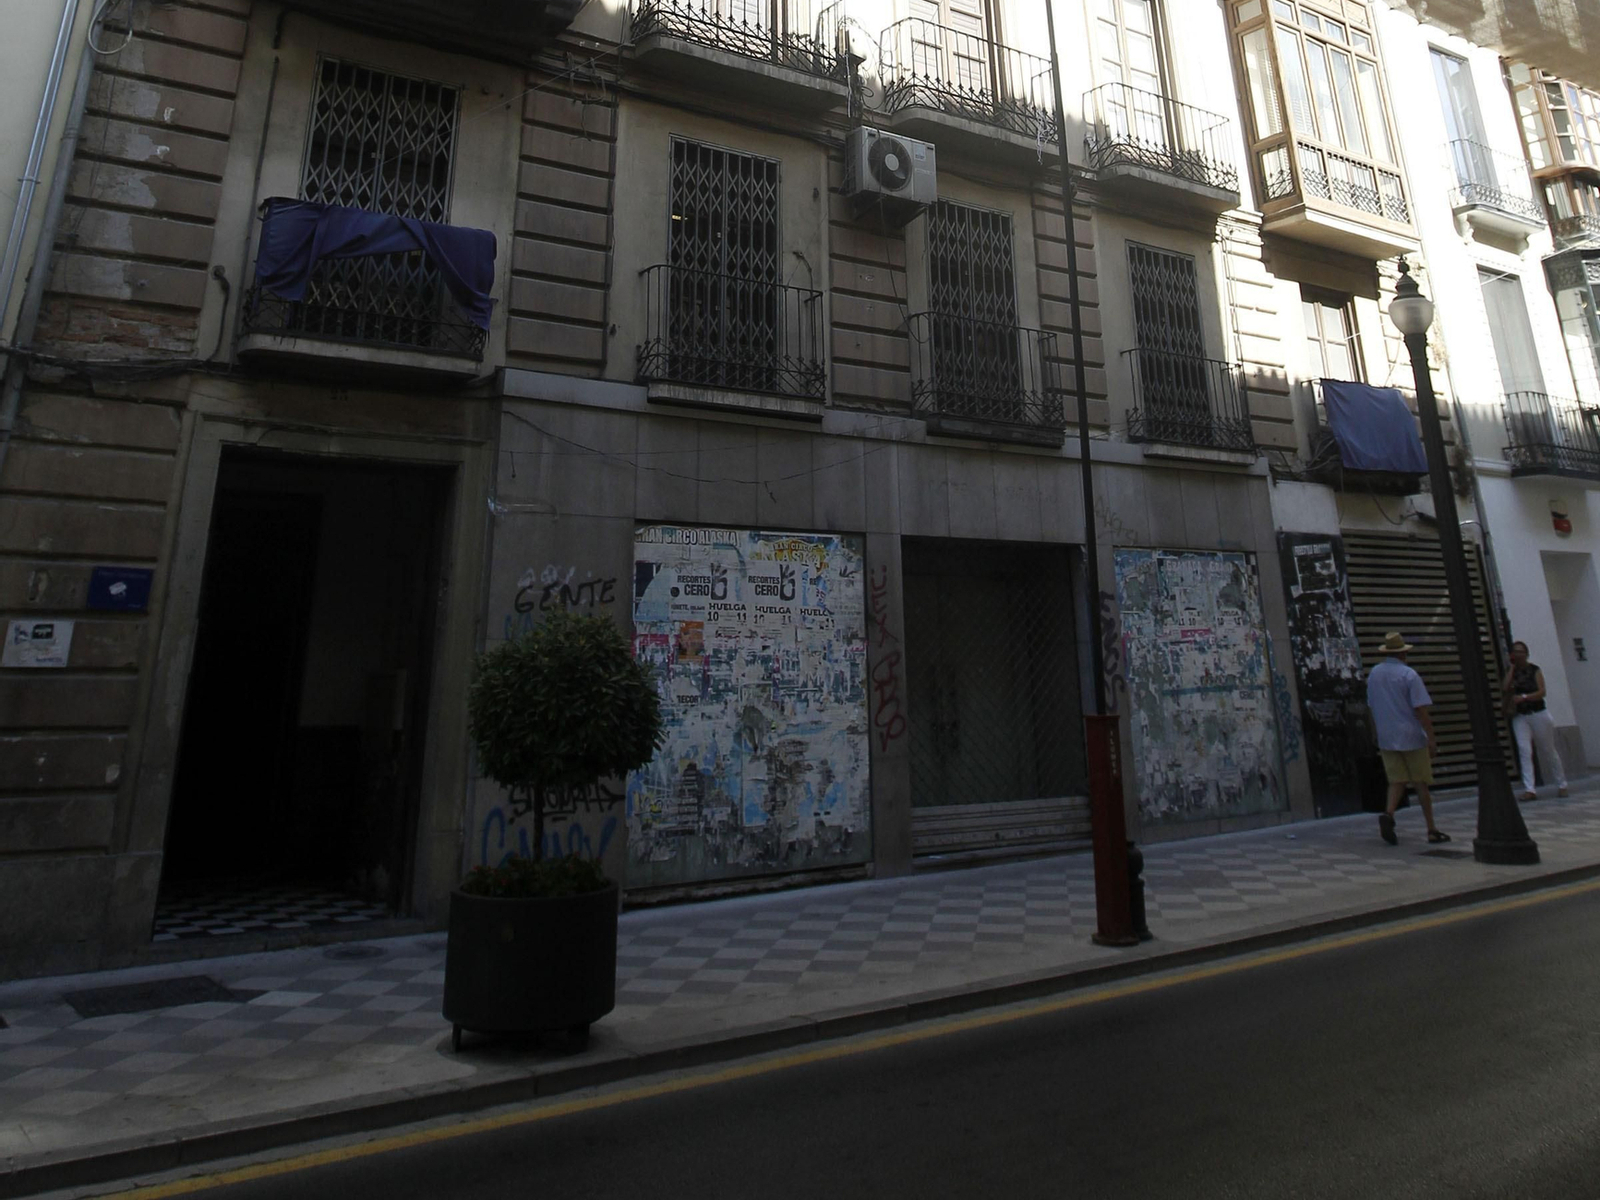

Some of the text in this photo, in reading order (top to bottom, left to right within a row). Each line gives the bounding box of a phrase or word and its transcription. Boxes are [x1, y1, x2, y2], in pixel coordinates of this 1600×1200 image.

[665, 528, 698, 545] CIRCO
[698, 530, 737, 547] ALASKA
[677, 575, 711, 584] RECORTES
[748, 575, 780, 585] RECORTES
[684, 584, 710, 596] CERO
[755, 584, 779, 596] CERO
[514, 578, 617, 614] GENTE
[709, 603, 747, 611] HUELGA
[708, 611, 719, 622] 10
